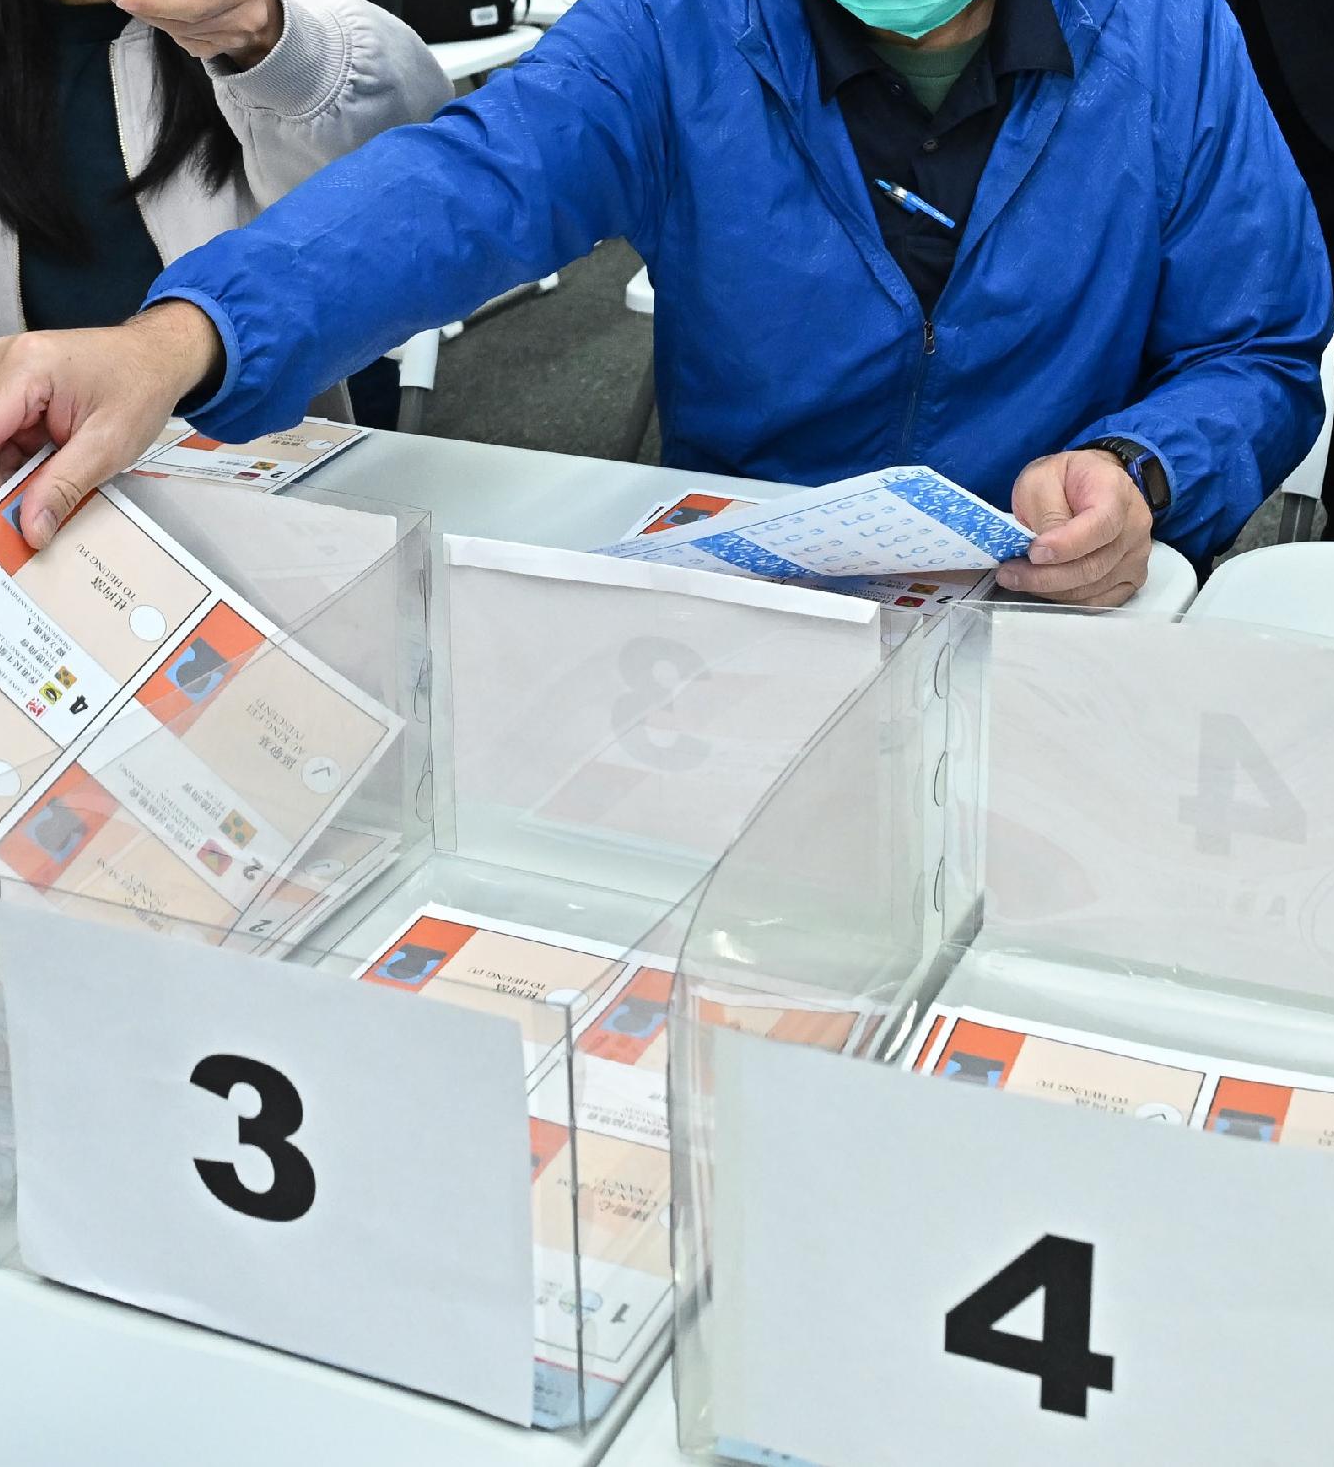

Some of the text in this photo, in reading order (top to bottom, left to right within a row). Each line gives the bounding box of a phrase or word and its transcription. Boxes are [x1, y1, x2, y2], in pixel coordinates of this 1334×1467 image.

[74, 542, 136, 600] TO HEUNG FU
[65, 693, 90, 717] 4
[239, 856, 265, 882] 2
[190, 1055, 315, 1222] 3
[945, 1235, 1113, 1417] 4
